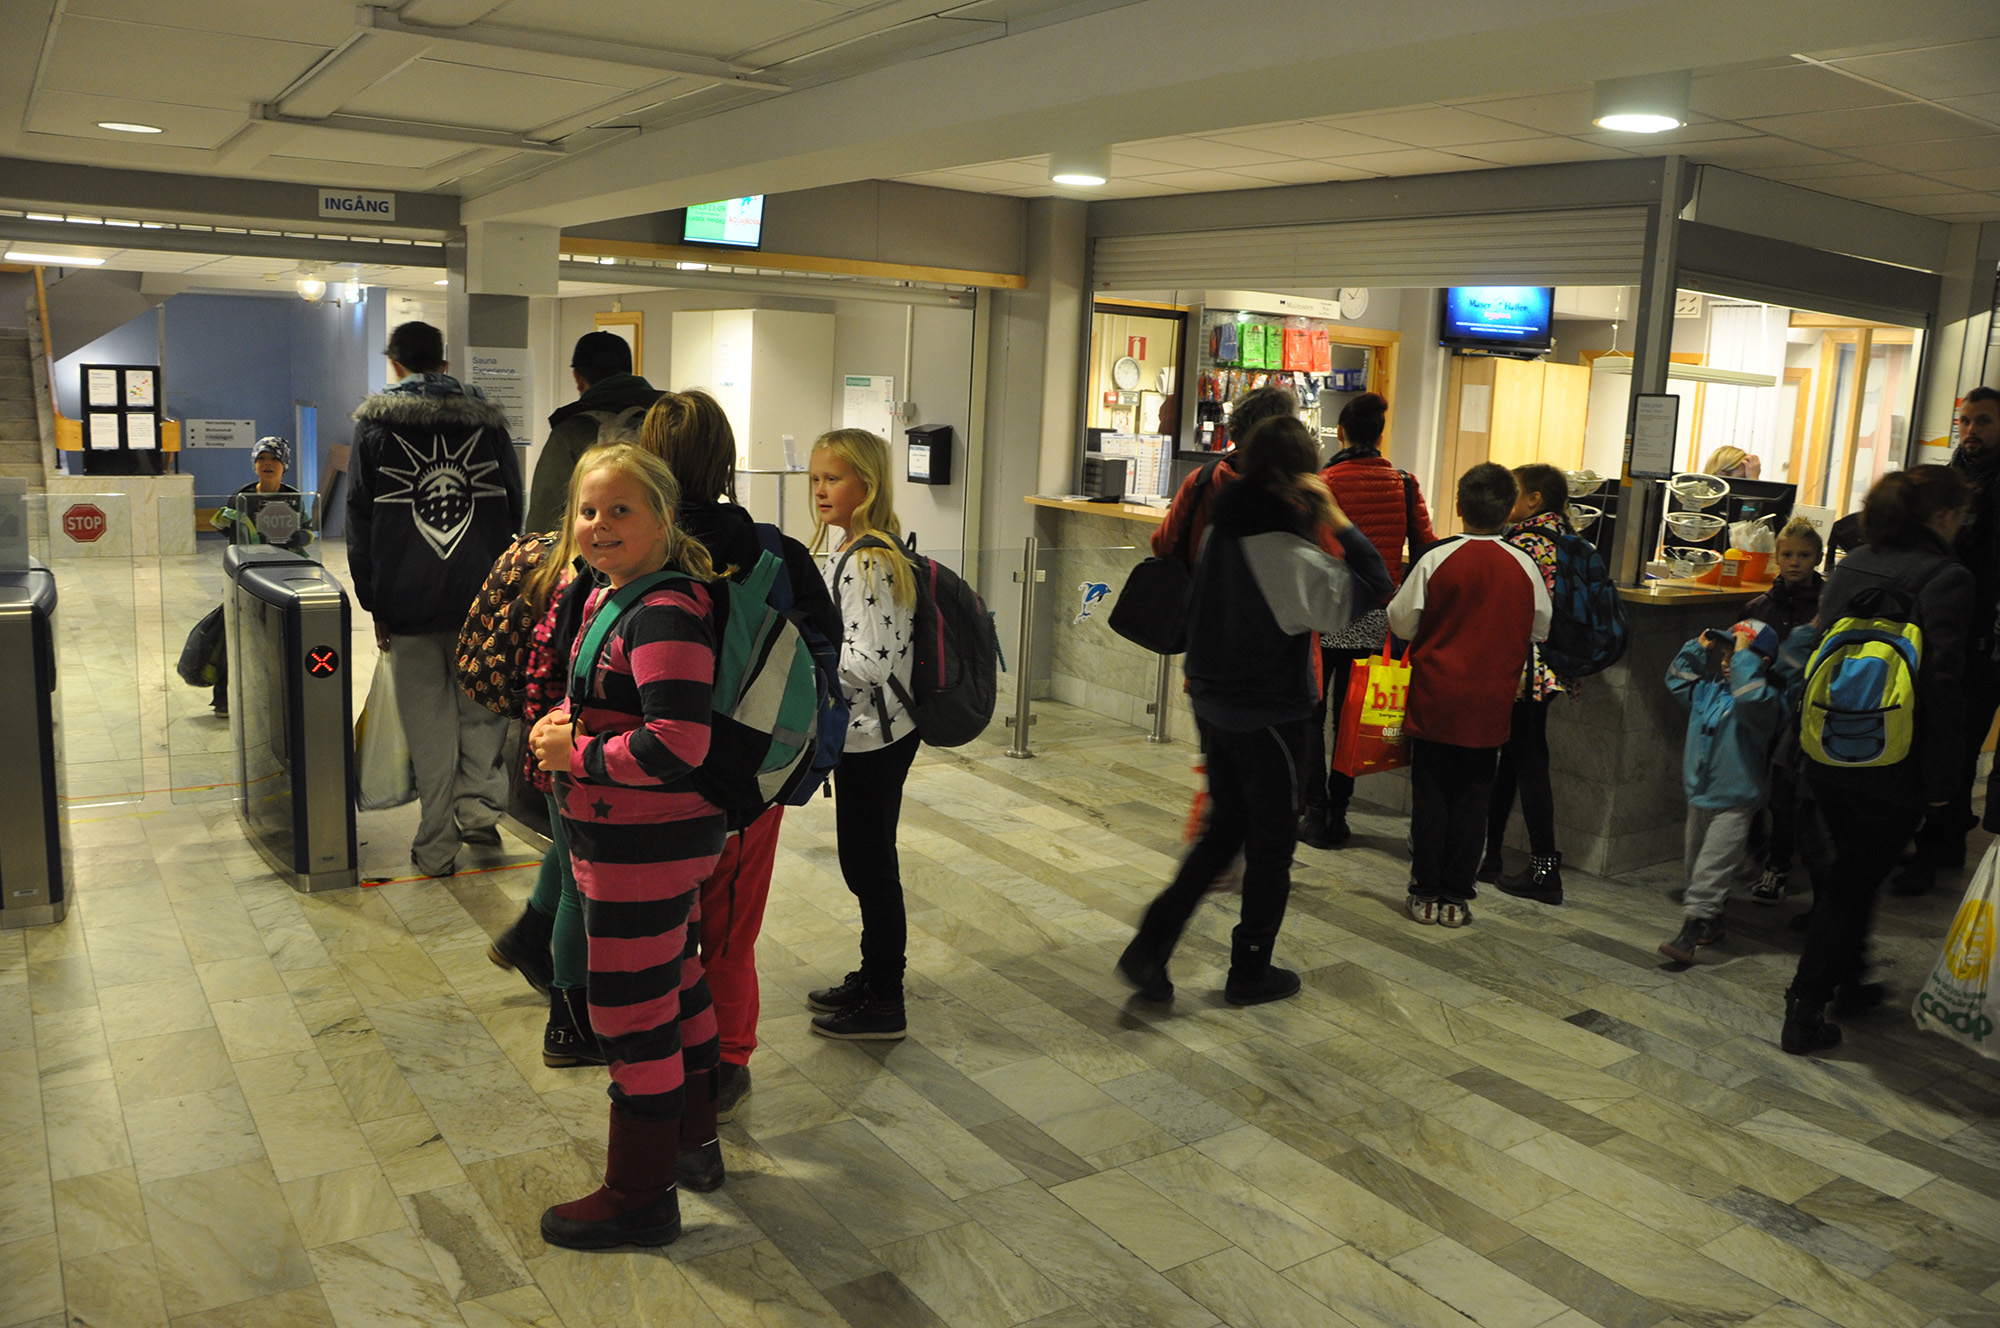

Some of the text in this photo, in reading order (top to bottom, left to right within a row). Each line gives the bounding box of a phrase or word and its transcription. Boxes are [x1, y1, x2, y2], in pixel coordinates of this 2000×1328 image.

[325, 195, 389, 213] INGÅNG
[472, 356, 497, 365] Sauna
[67, 516, 103, 531] STOP
